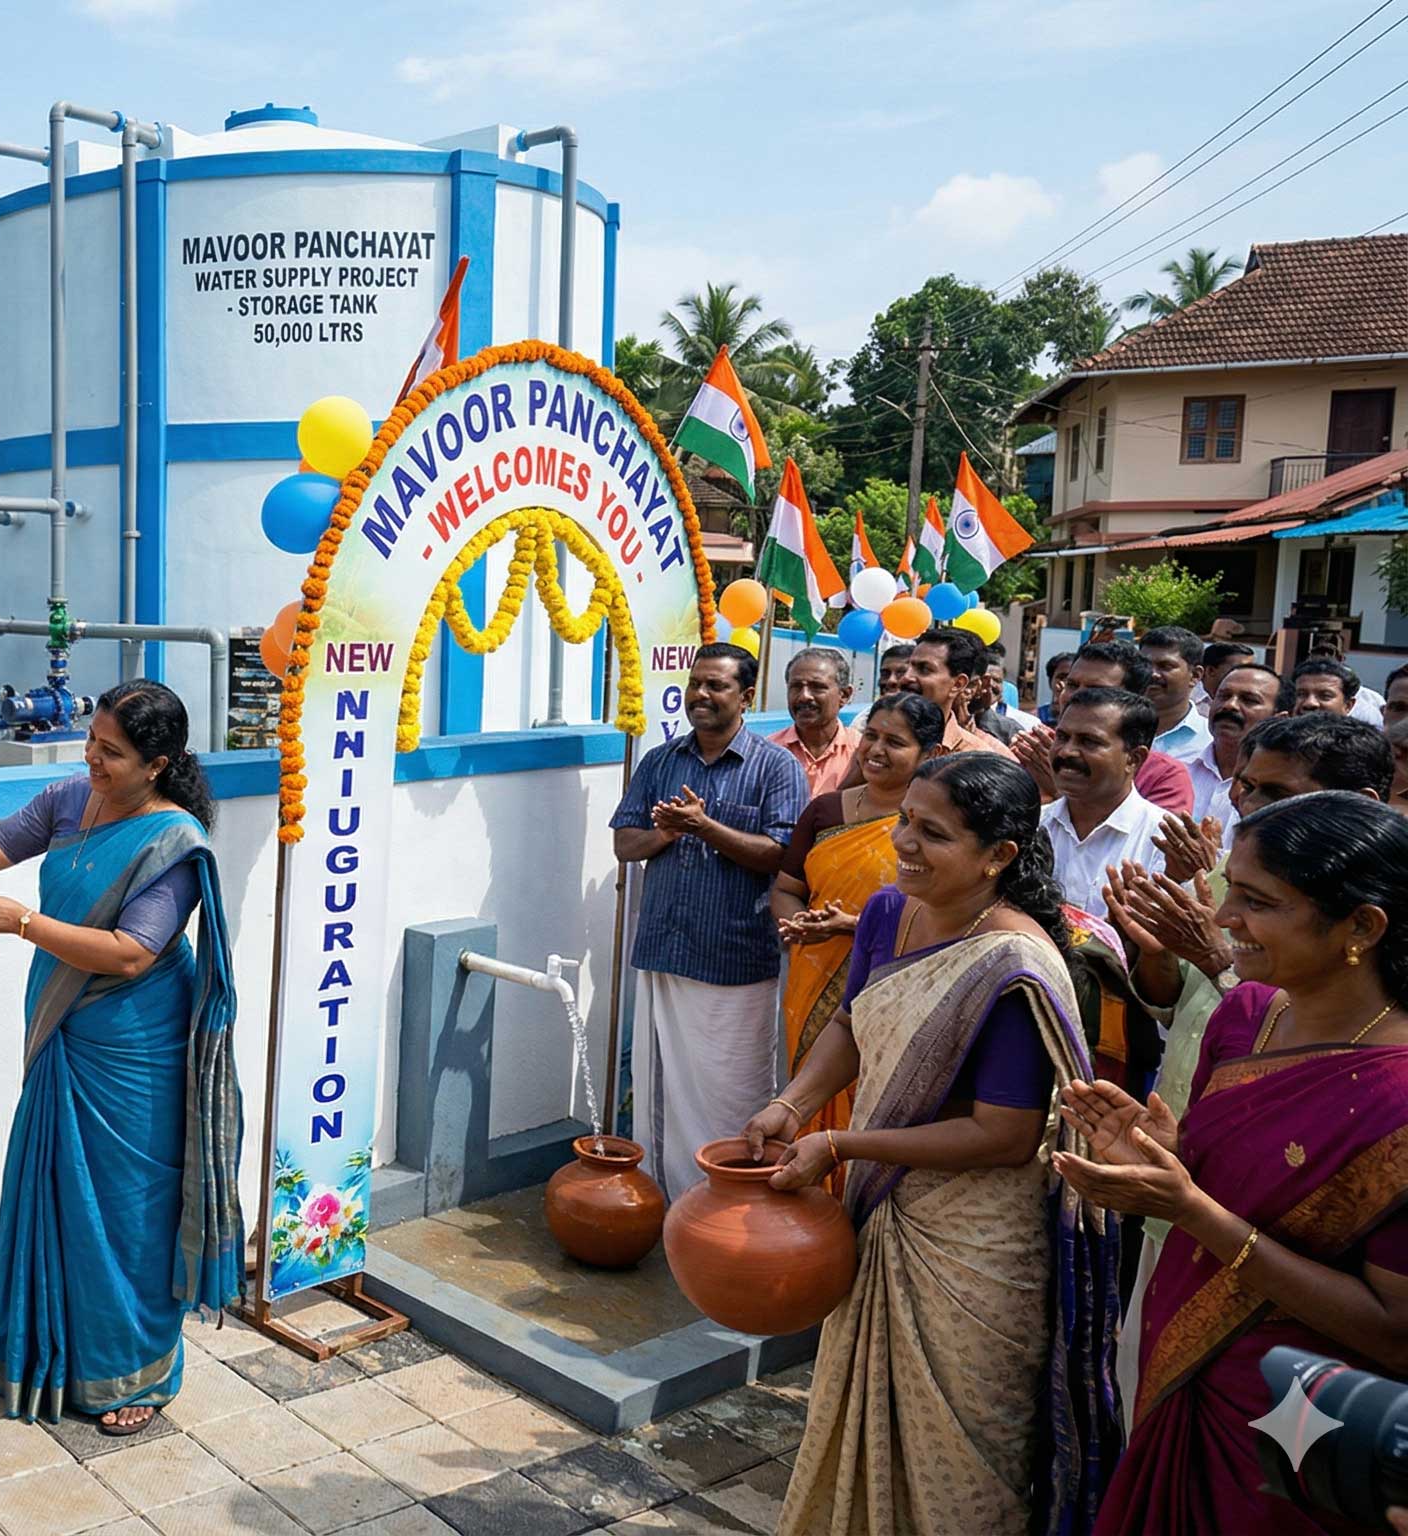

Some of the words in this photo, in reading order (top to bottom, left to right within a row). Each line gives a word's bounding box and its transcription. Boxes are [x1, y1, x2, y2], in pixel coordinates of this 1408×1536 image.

[183, 233, 285, 264] MAVOOR
[295, 231, 434, 259] PANCHAYAT
[196, 270, 256, 291] WATER
[263, 267, 331, 288] SUPPLY
[339, 268, 418, 287] PROJECT
[239, 295, 323, 316] STORAGE
[330, 295, 376, 313] TANK
[255, 323, 312, 347] 50,000
[320, 323, 362, 341] LTRS
[361, 383, 515, 560] MAVOOR
[528, 380, 685, 572] PANCHAYAT
[429, 446, 590, 541] WELCOMES
[598, 484, 641, 564] YOU
[326, 644, 393, 672] NEW
[652, 646, 695, 671] NEW
